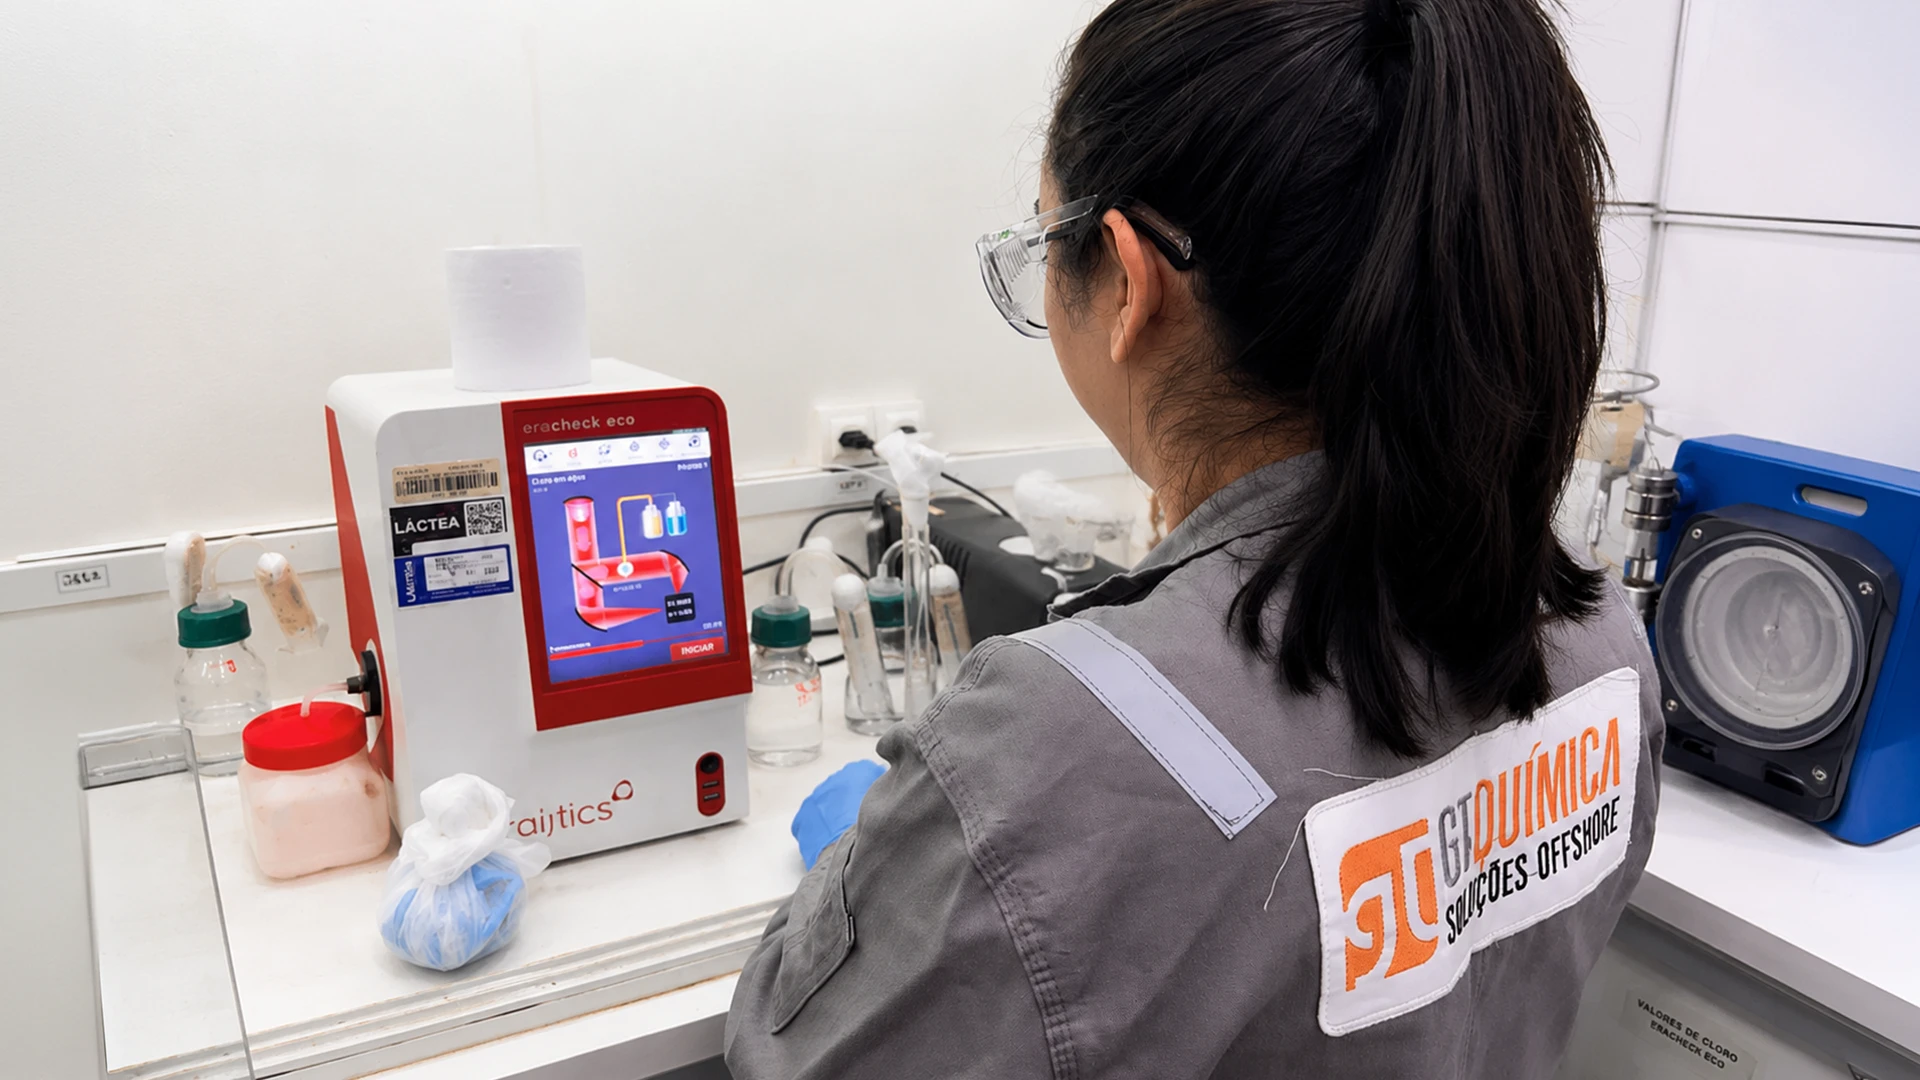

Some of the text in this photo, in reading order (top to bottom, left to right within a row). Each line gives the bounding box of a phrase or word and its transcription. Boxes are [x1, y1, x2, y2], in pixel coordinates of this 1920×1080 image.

[523, 416, 635, 434] eracheck eco
[394, 516, 460, 535] LÁCTEA
[1445, 795, 1620, 945] SOLUÇÕES OFFSHORE
[1637, 998, 1739, 1063] VALORES DE CLORO
[1650, 1019, 1726, 1069] ERACHECK ECO
